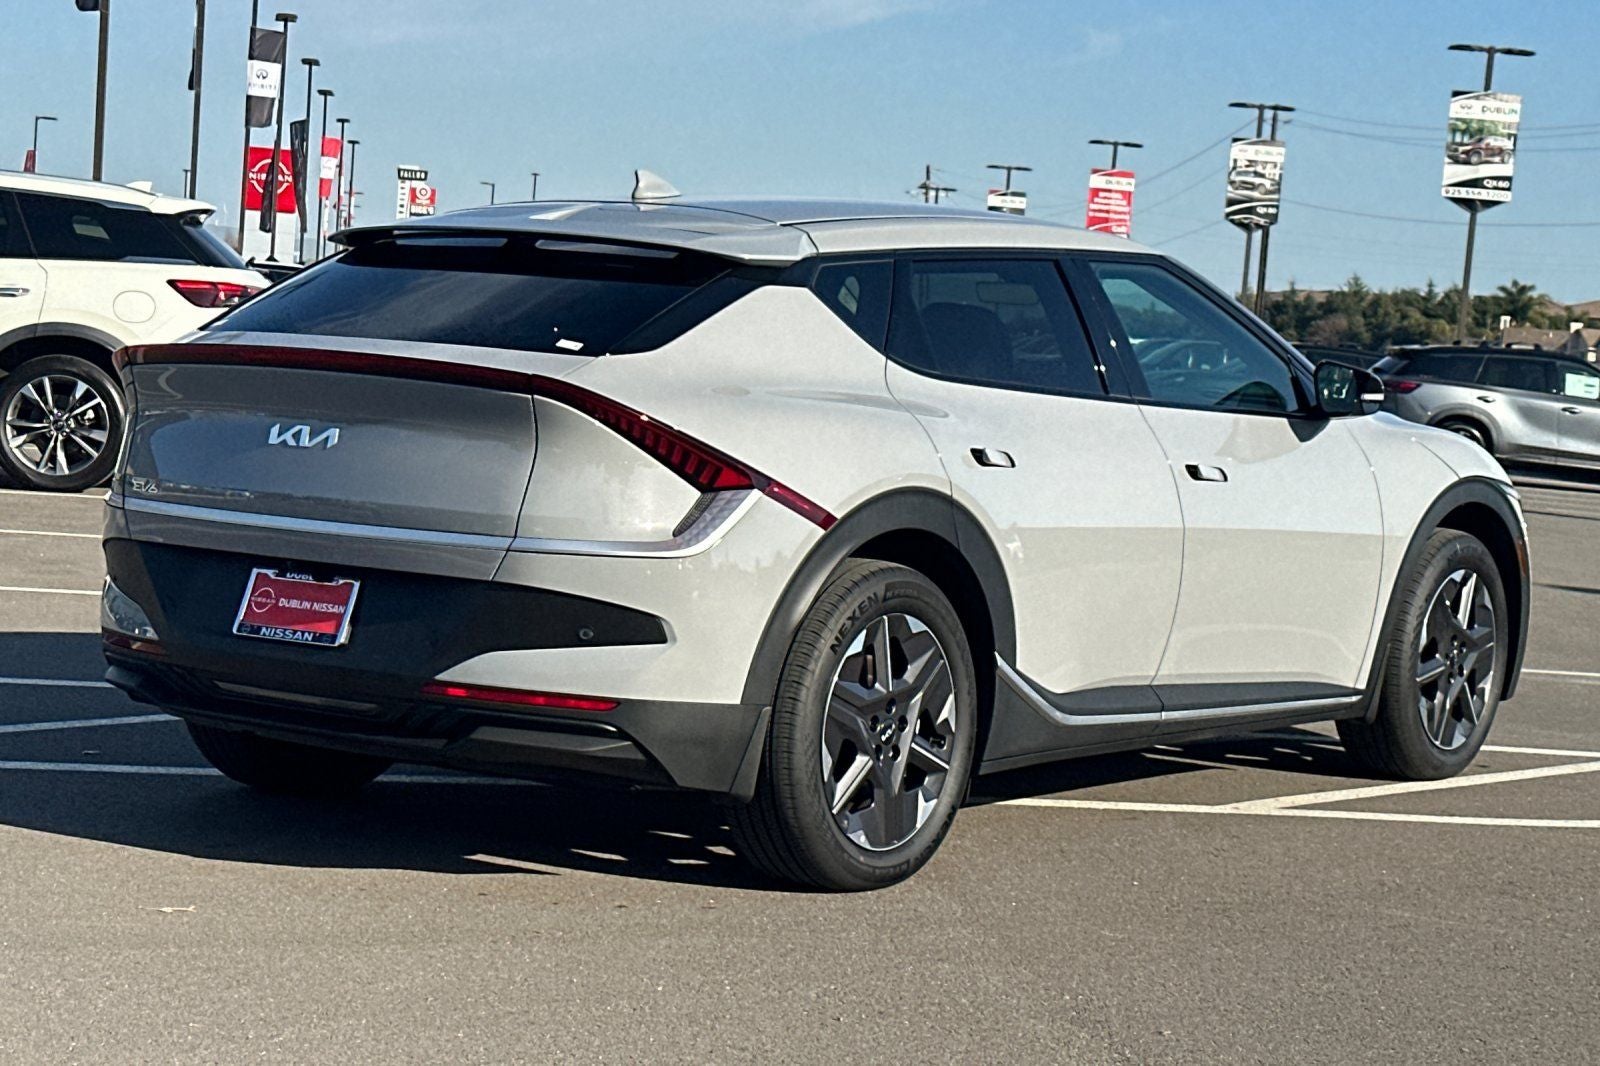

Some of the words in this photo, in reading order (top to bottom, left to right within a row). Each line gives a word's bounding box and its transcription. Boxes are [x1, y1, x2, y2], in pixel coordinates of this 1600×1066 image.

[1481, 105, 1518, 115] DUBLIN
[249, 172, 293, 183] NISAN
[1483, 178, 1510, 189] QX60
[268, 423, 340, 449] KIA
[132, 478, 158, 494] EV6
[250, 596, 276, 604] NISSAN
[278, 597, 312, 610] DUBLIN
[312, 602, 346, 614] NISSAN
[829, 591, 879, 655] NEXEN
[260, 626, 314, 642] NISSAN
